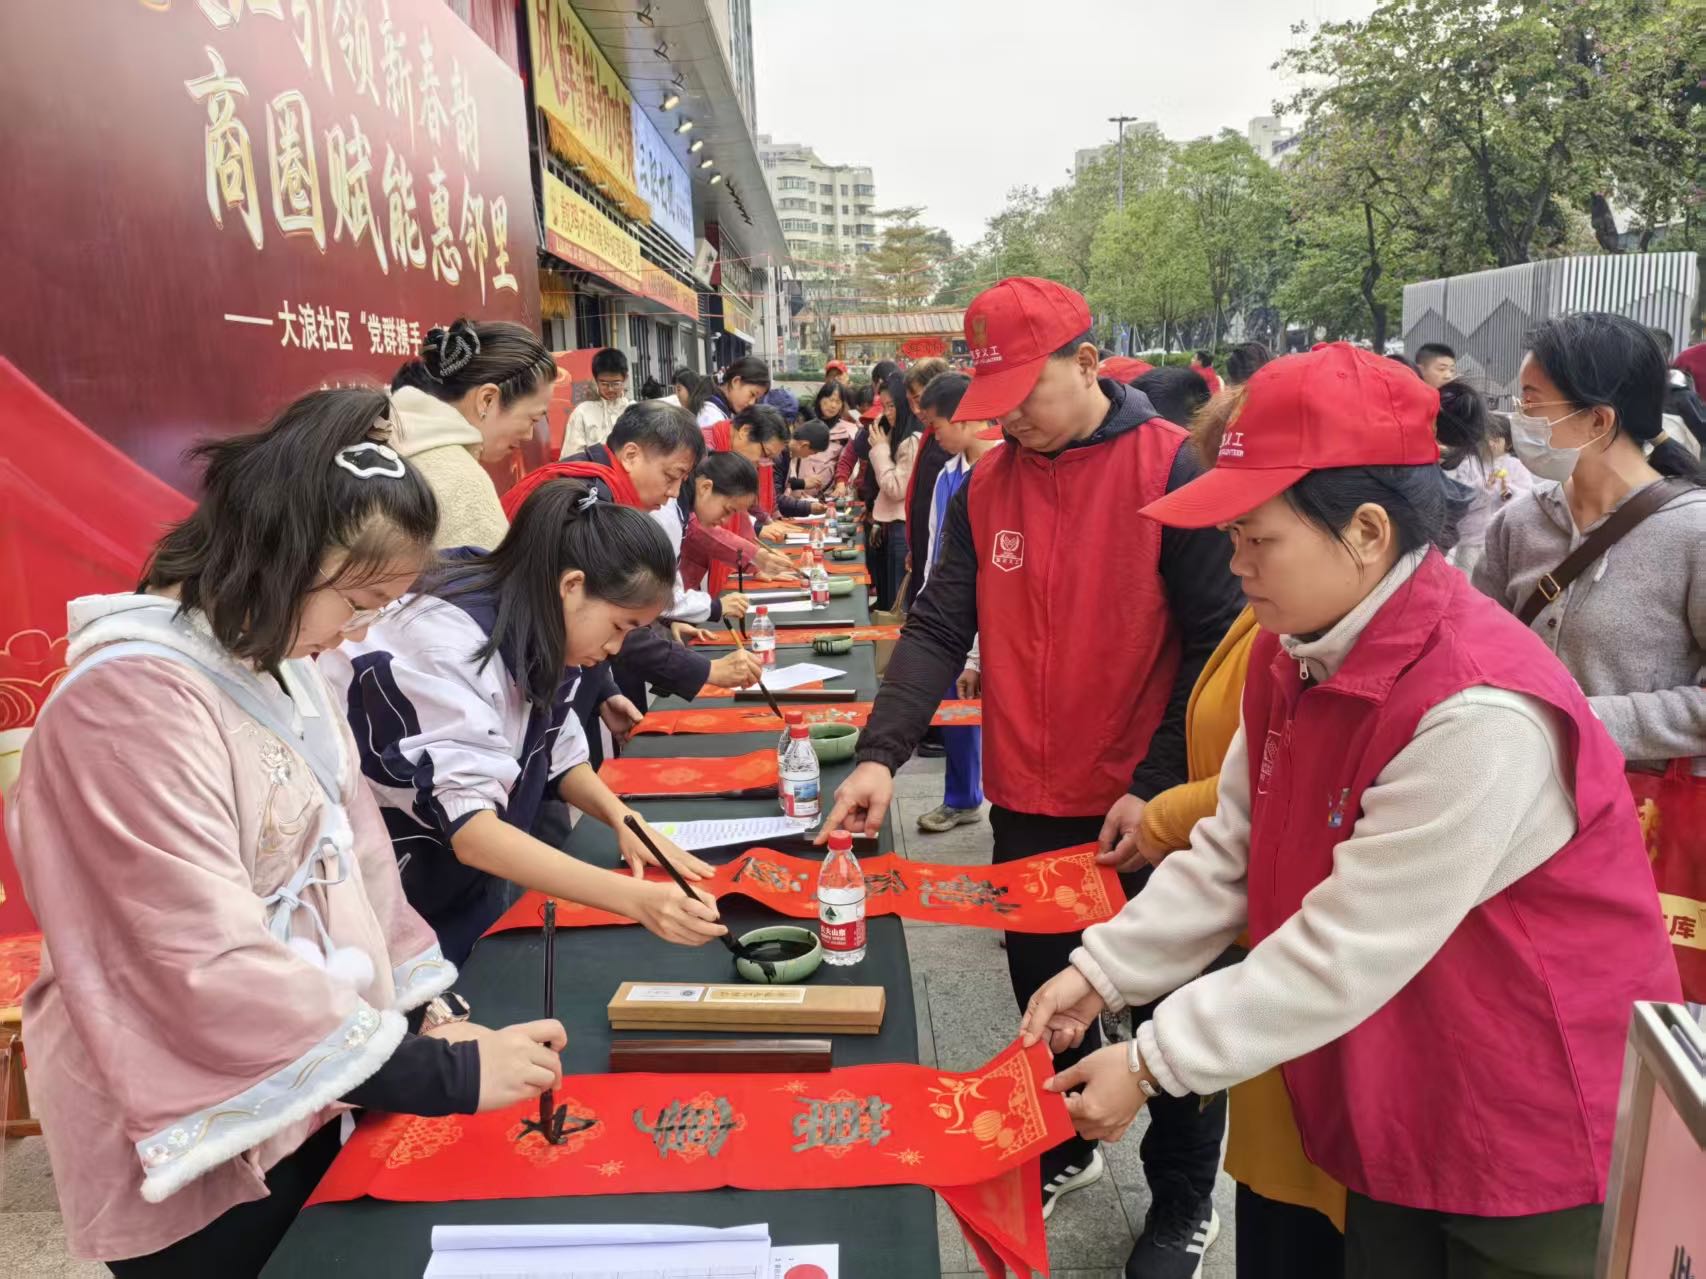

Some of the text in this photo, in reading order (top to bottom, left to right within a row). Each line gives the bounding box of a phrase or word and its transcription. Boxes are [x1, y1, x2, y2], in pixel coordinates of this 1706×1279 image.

[197, 0, 480, 173] 引领新春韵
[184, 44, 519, 306] 商圈赋能惠邻里
[1663, 914, 1697, 939] 库
